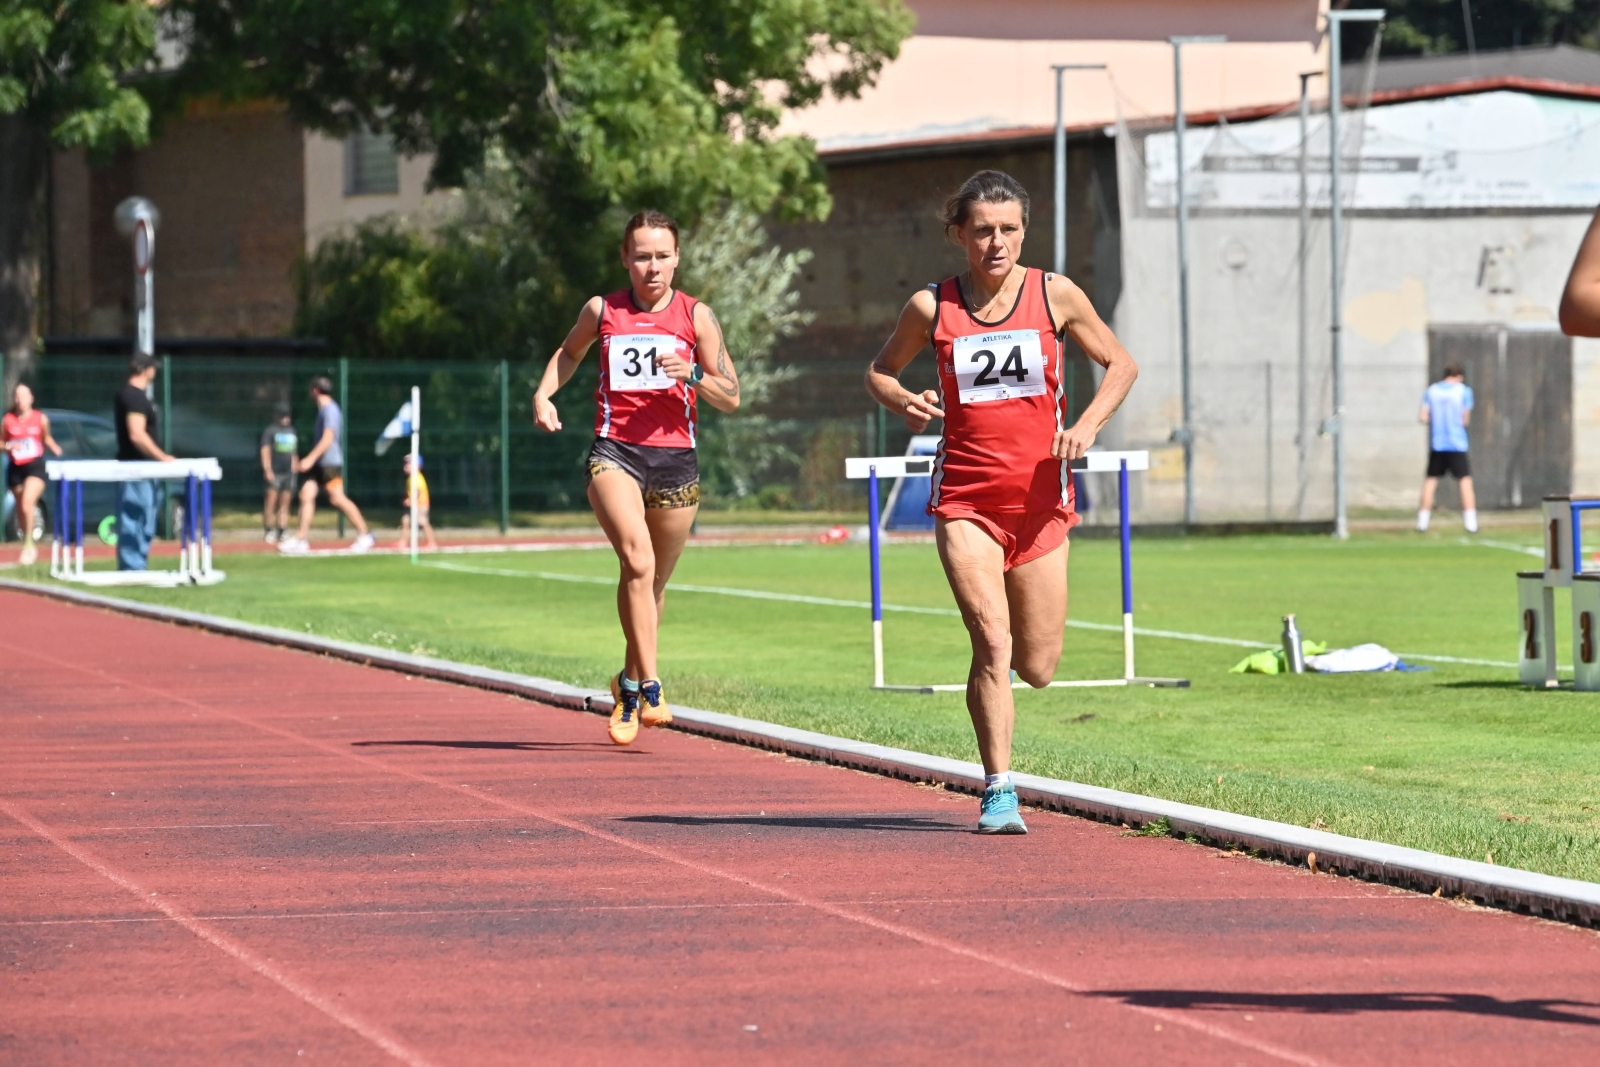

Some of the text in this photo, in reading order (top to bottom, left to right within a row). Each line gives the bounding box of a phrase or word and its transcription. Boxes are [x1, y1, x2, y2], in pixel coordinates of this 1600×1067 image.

[982, 334, 1012, 343] ATLETIKA
[622, 347, 658, 377] 31
[970, 345, 1029, 387] 24
[1549, 519, 1560, 570] 1
[1523, 608, 1538, 659] 2
[1580, 611, 1594, 664] 3
